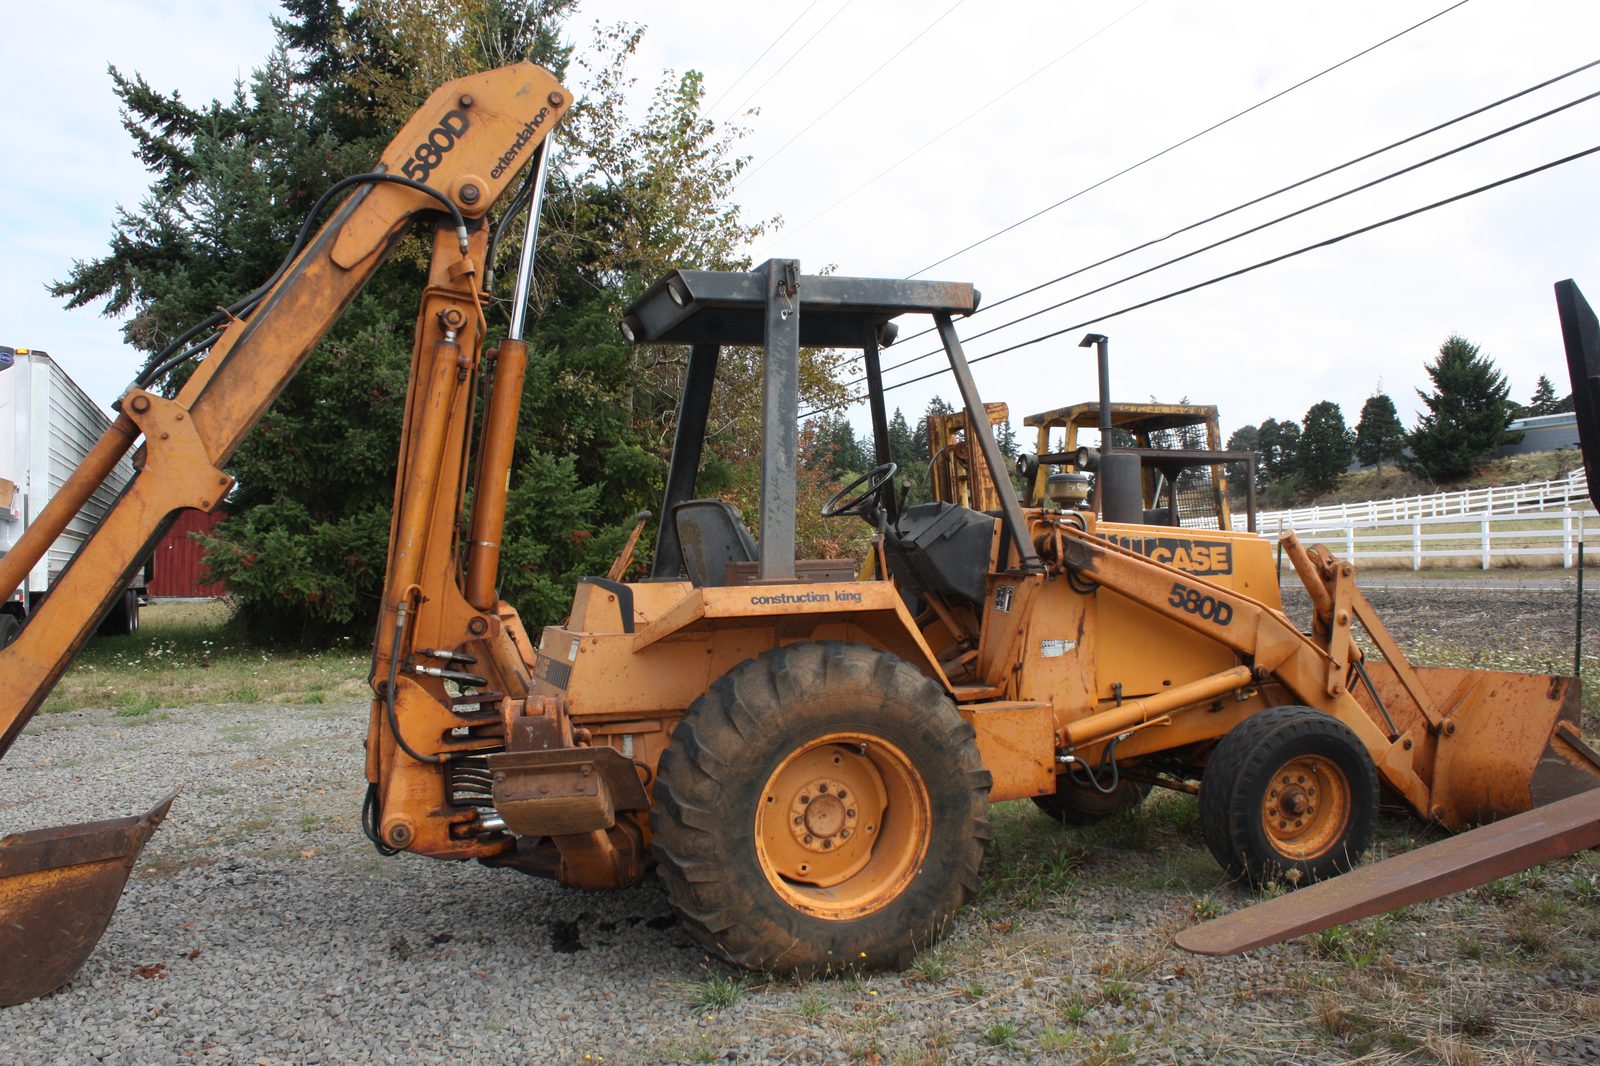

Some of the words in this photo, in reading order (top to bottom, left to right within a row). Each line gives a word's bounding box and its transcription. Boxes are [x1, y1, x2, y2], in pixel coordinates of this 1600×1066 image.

[401, 109, 470, 184] 580D
[490, 106, 549, 180] extendahoe
[1149, 543, 1229, 572] CASE
[750, 592, 830, 605] construction
[834, 590, 862, 603] king
[1167, 582, 1233, 626] 580D
